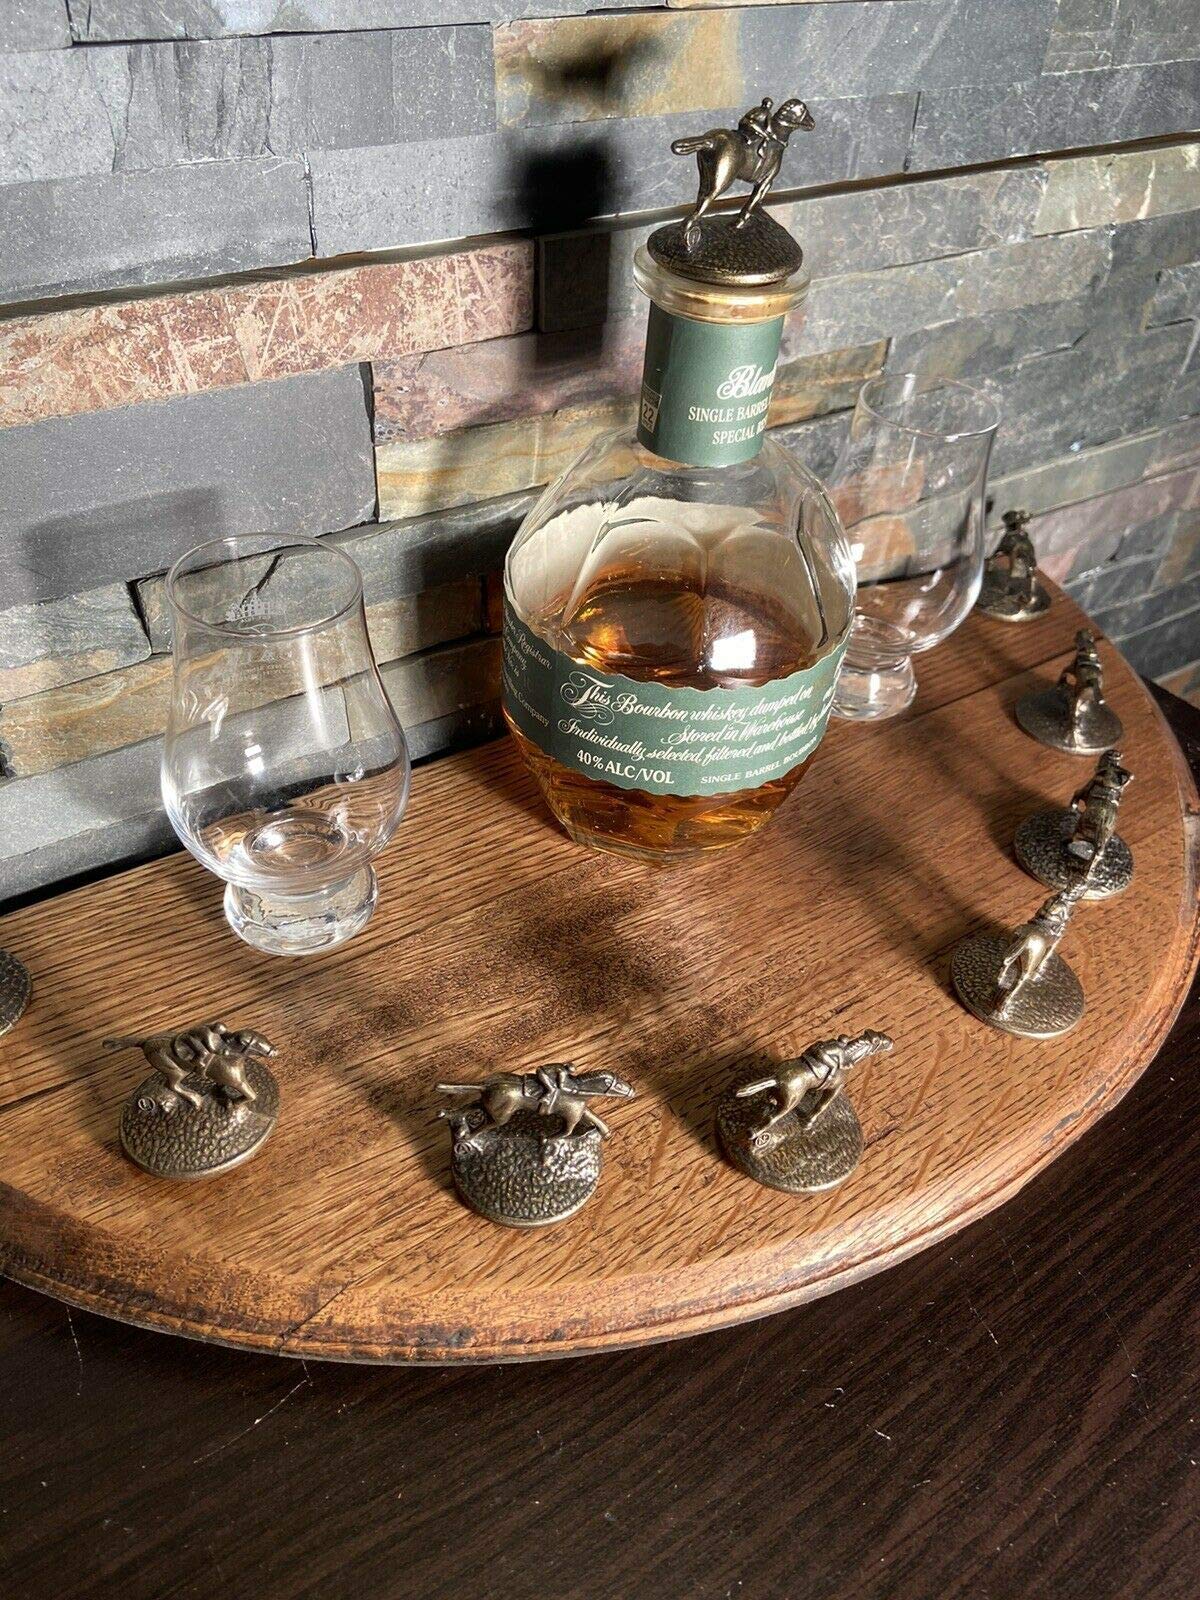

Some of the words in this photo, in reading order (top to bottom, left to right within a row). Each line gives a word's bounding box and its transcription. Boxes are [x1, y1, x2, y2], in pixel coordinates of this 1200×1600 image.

[688, 406, 734, 422] SINGLE
[712, 424, 756, 445] SPECIAL
[560, 671, 615, 725] This
[611, 692, 690, 723] Bourbon
[688, 702, 750, 725] whiskey
[749, 685, 805, 716] dumped
[557, 718, 647, 762] Individually
[701, 741, 757, 767] filtered
[753, 732, 782, 756] and
[660, 724, 728, 745] Stored
[723, 722, 739, 741] in
[576, 749, 604, 770] 40%
[605, 760, 675, 785] ALC/VOL
[700, 772, 742, 784] SINGLE
[744, 760, 782, 780] BARREL
